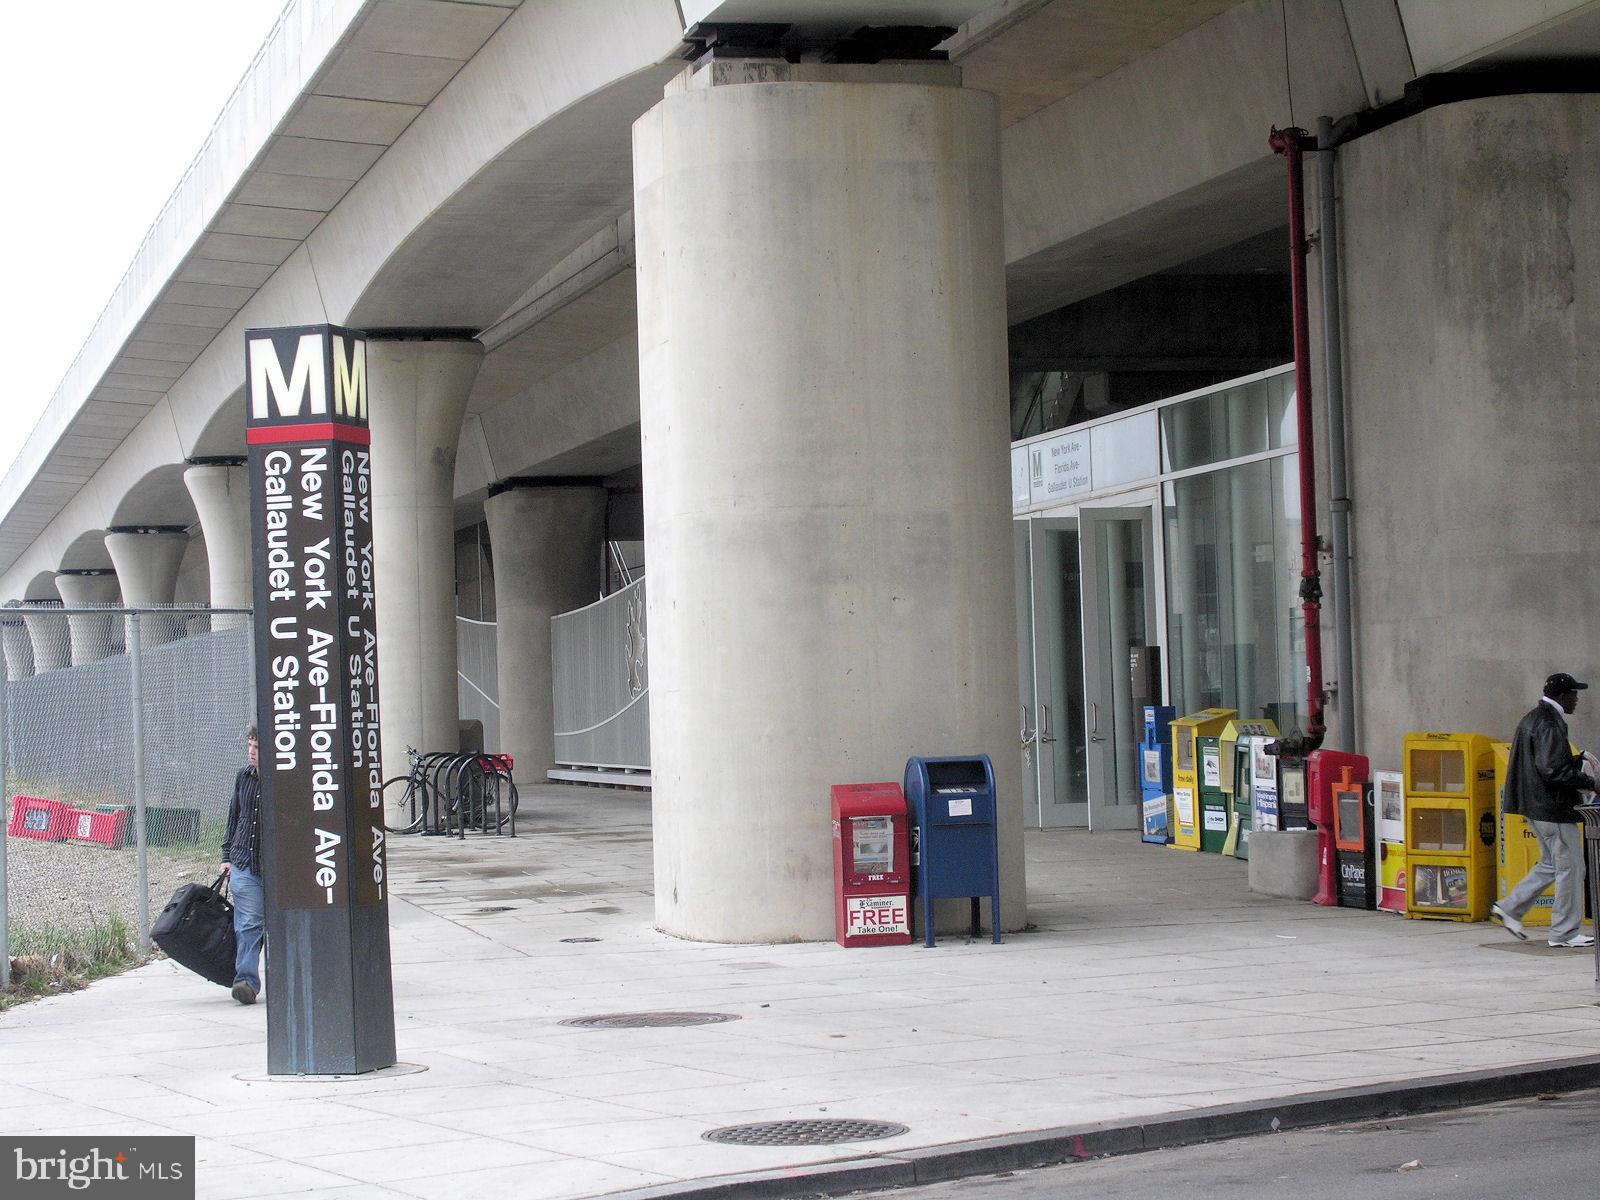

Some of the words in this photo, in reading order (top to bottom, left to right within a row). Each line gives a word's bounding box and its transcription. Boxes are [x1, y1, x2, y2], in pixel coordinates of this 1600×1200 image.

[249, 334, 327, 420] M
[332, 334, 367, 420] M
[300, 448, 327, 521] New
[356, 451, 370, 523] New
[264, 450, 296, 602] Gallaudet
[341, 450, 359, 599] Gallaudet
[303, 537, 332, 611] York
[360, 541, 374, 611] York
[270, 616, 298, 639] U
[347, 615, 360, 638] U
[271, 655, 301, 771] Station
[349, 654, 364, 768] Station
[1523, 829, 1538, 839] fre
[850, 908, 905, 926] FREE
[857, 926, 876, 934] Take
[878, 925, 898, 933] One!
